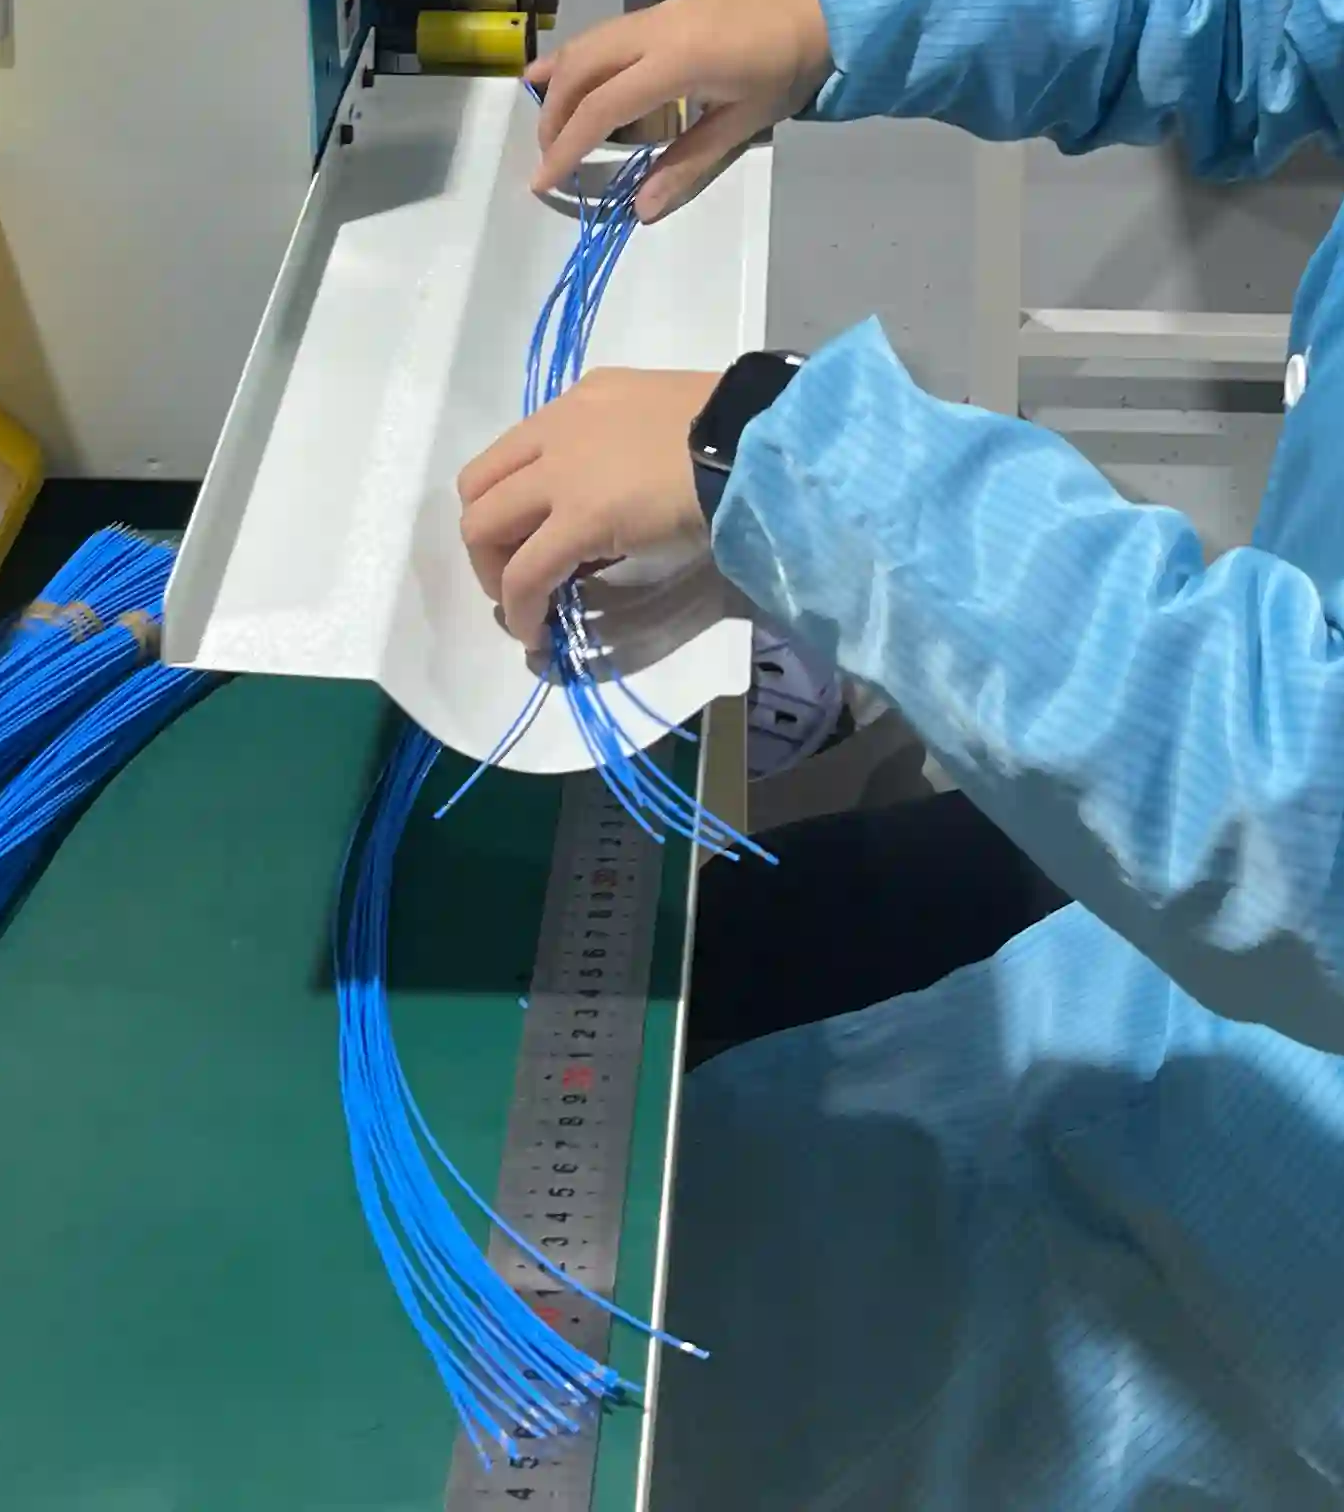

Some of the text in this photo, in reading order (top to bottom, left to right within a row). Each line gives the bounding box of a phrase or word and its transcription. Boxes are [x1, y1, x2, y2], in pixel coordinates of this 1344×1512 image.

[582, 948, 606, 958] 6
[579, 968, 604, 978] 5
[577, 989, 602, 998] 4
[574, 1009, 599, 1018] 3
[571, 1029, 597, 1039] 2
[561, 1094, 588, 1104] 9
[558, 1116, 584, 1126] 8
[555, 1140, 581, 1149] 7
[552, 1163, 579, 1173] 6
[548, 1187, 576, 1197] 5
[544, 1211, 573, 1223] 4
[540, 1236, 568, 1247] 3
[509, 1456, 539, 1469] 5
[504, 1487, 535, 1500] 4
